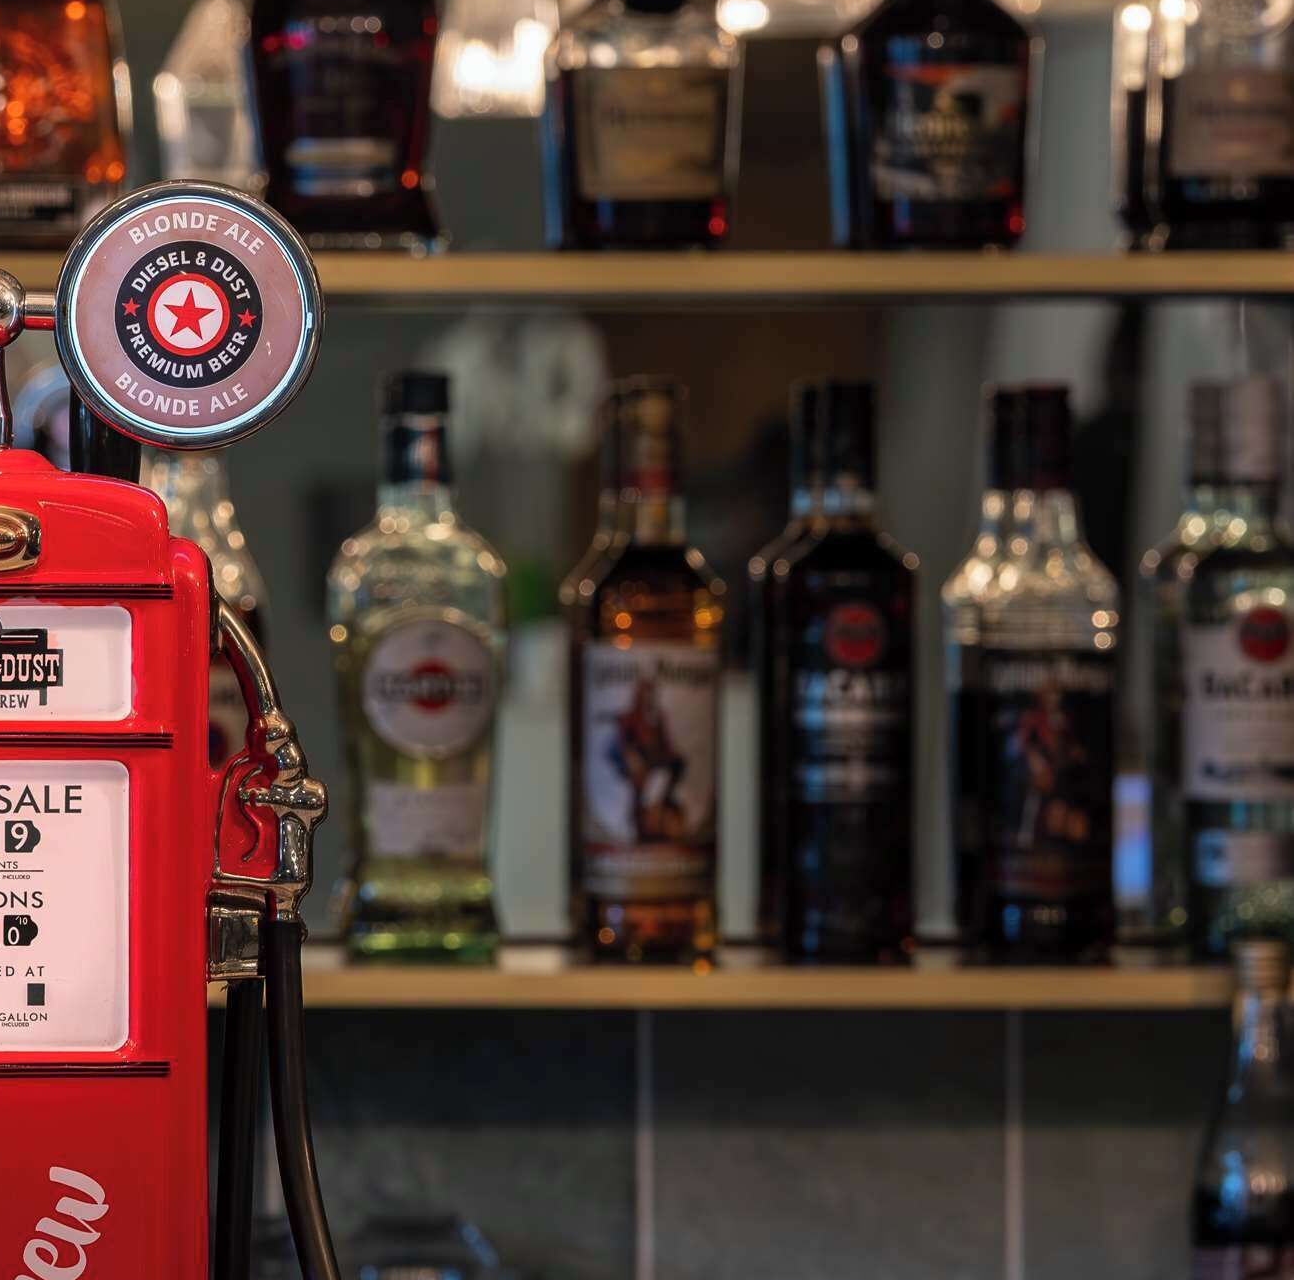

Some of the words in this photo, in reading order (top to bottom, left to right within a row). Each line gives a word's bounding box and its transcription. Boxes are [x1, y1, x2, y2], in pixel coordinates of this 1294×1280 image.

[128, 212, 219, 245] BLONDE
[223, 223, 266, 256] ALE
[131, 250, 190, 293] DIESEL
[195, 251, 206, 266] &
[210, 257, 251, 301] DUST
[126, 322, 203, 379] PREMIUM
[208, 332, 248, 373] BEER
[115, 372, 200, 416] BLONDE
[209, 383, 249, 413] ALE
[25, 966, 45, 977] AT
